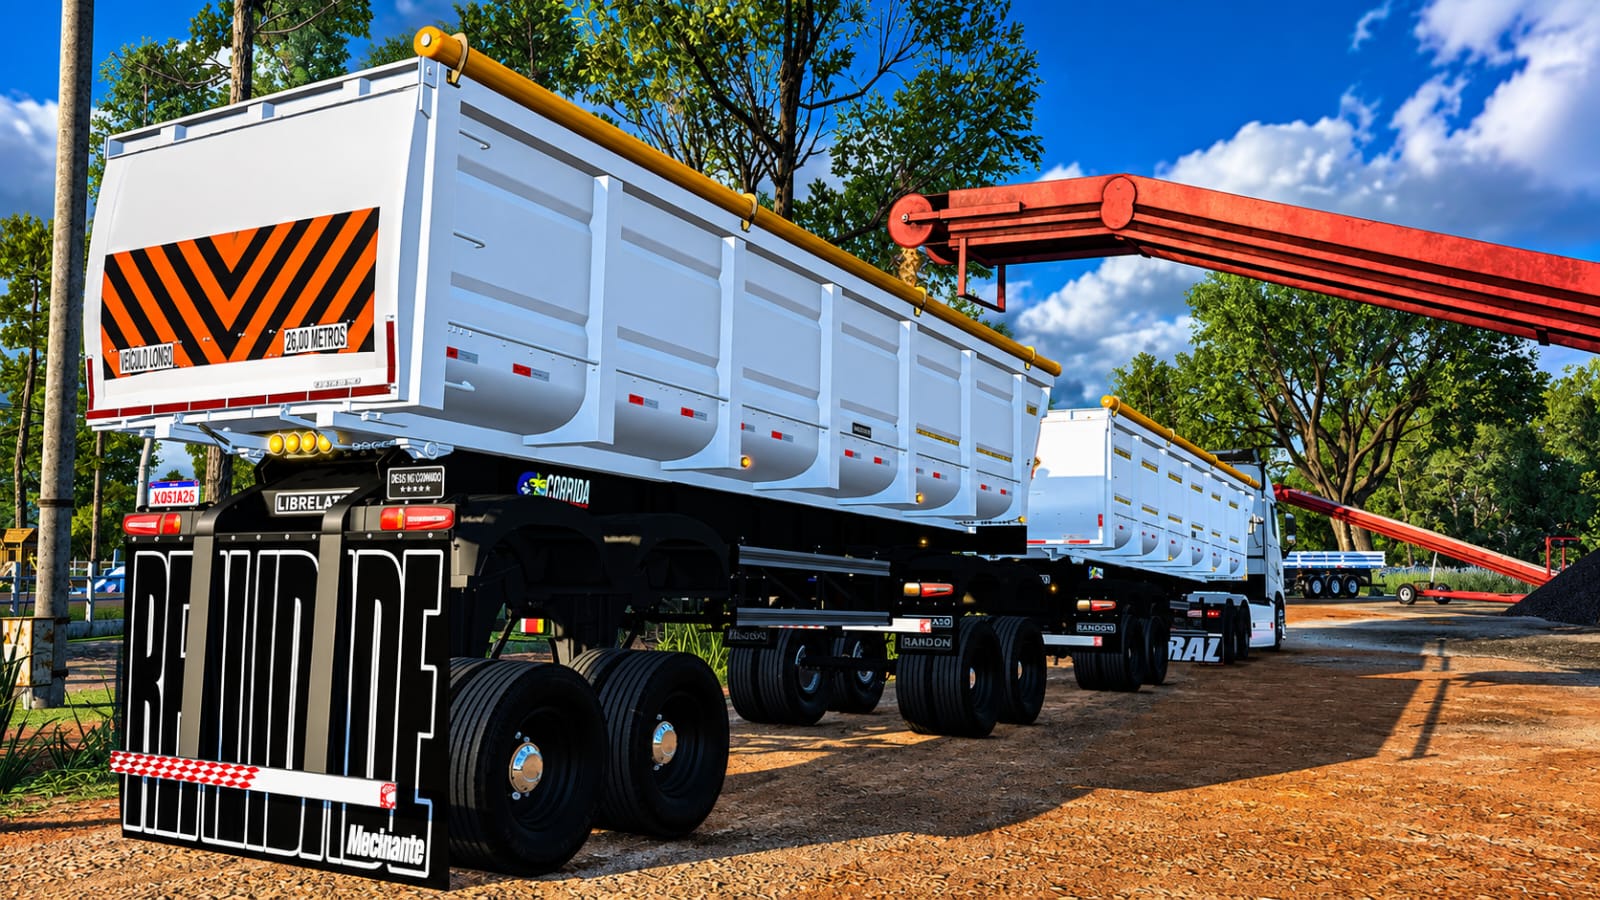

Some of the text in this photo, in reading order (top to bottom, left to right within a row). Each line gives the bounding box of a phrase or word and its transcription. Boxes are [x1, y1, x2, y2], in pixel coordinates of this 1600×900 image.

[285, 326, 346, 352] 26,00 METROS
[149, 345, 173, 368] LONGO
[903, 637, 951, 648] RANDON
